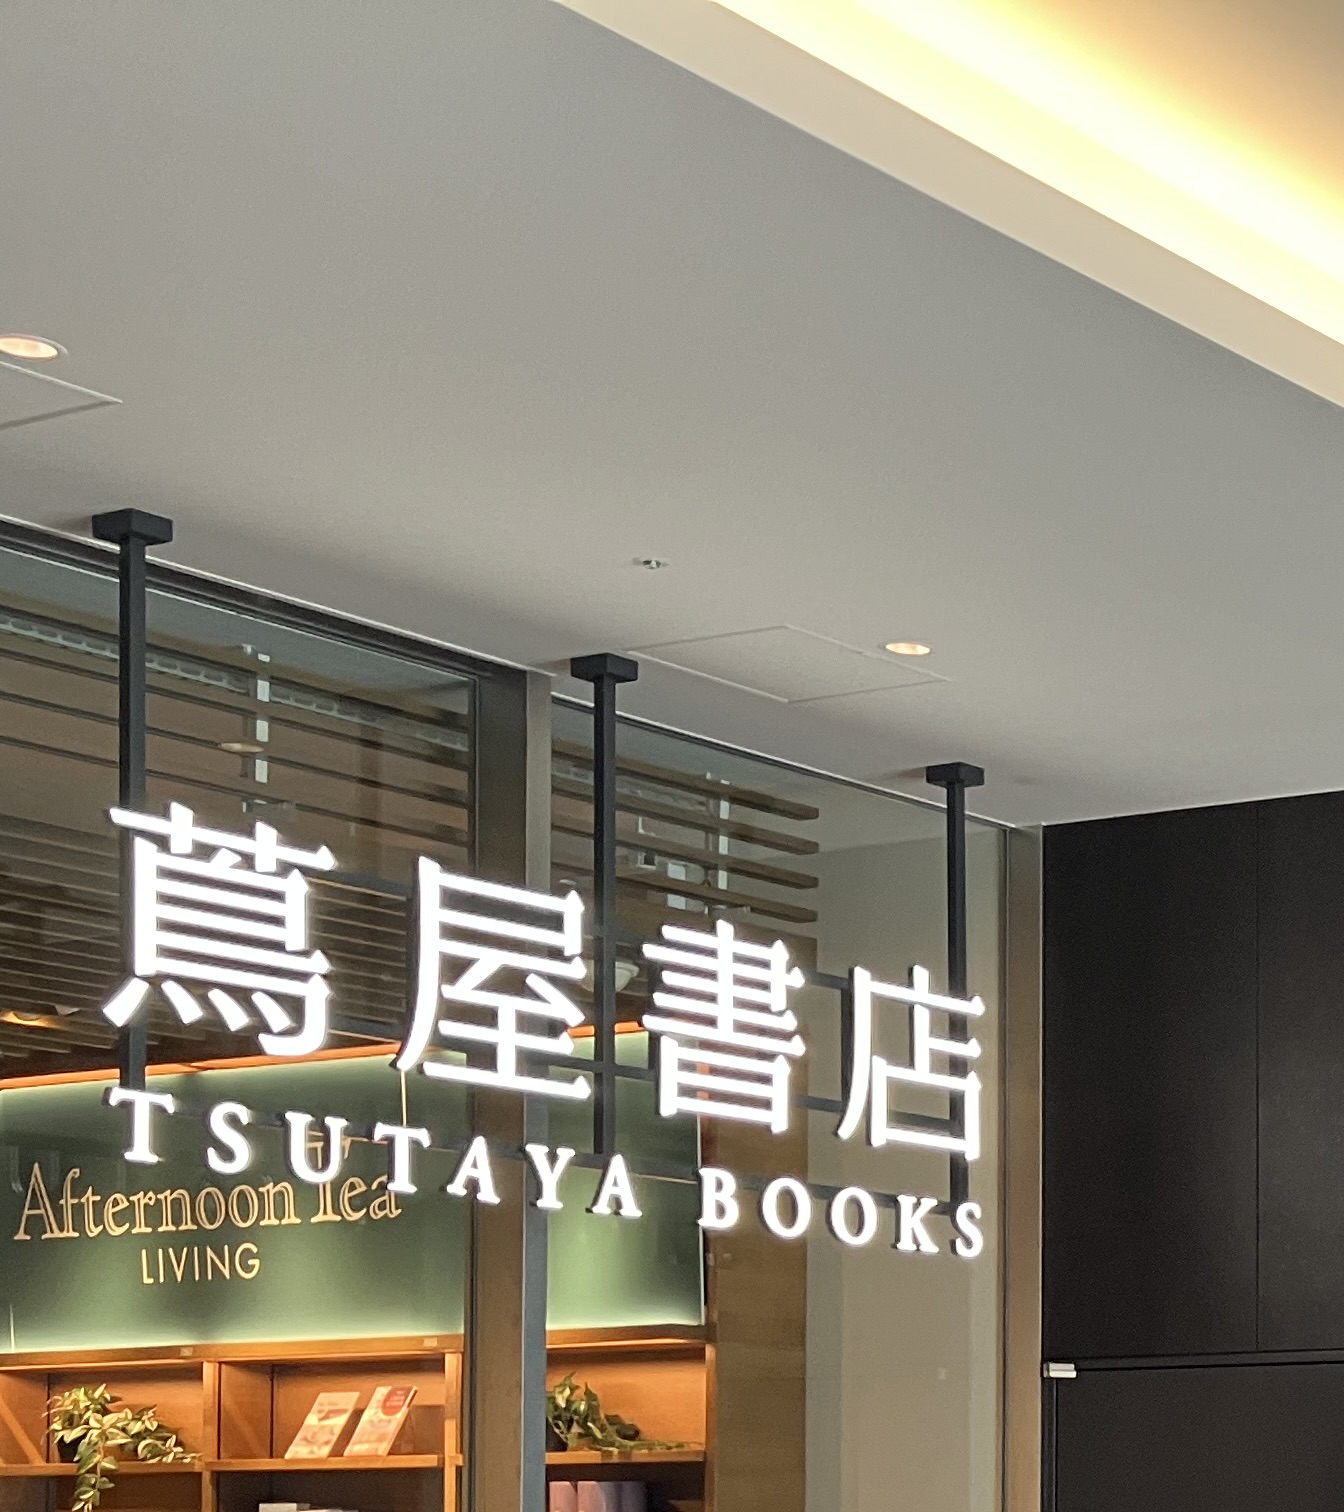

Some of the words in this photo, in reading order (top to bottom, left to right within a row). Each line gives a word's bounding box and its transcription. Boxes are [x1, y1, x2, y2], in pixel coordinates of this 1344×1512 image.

[102, 799, 986, 1164] 蔦屋書店
[13, 1161, 302, 1241] Afternoon
[306, 1131, 403, 1224] Tea
[108, 1086, 643, 1218] TSUTAYA
[697, 1168, 985, 1260] BOOKS
[140, 1242, 261, 1285] LIVING
